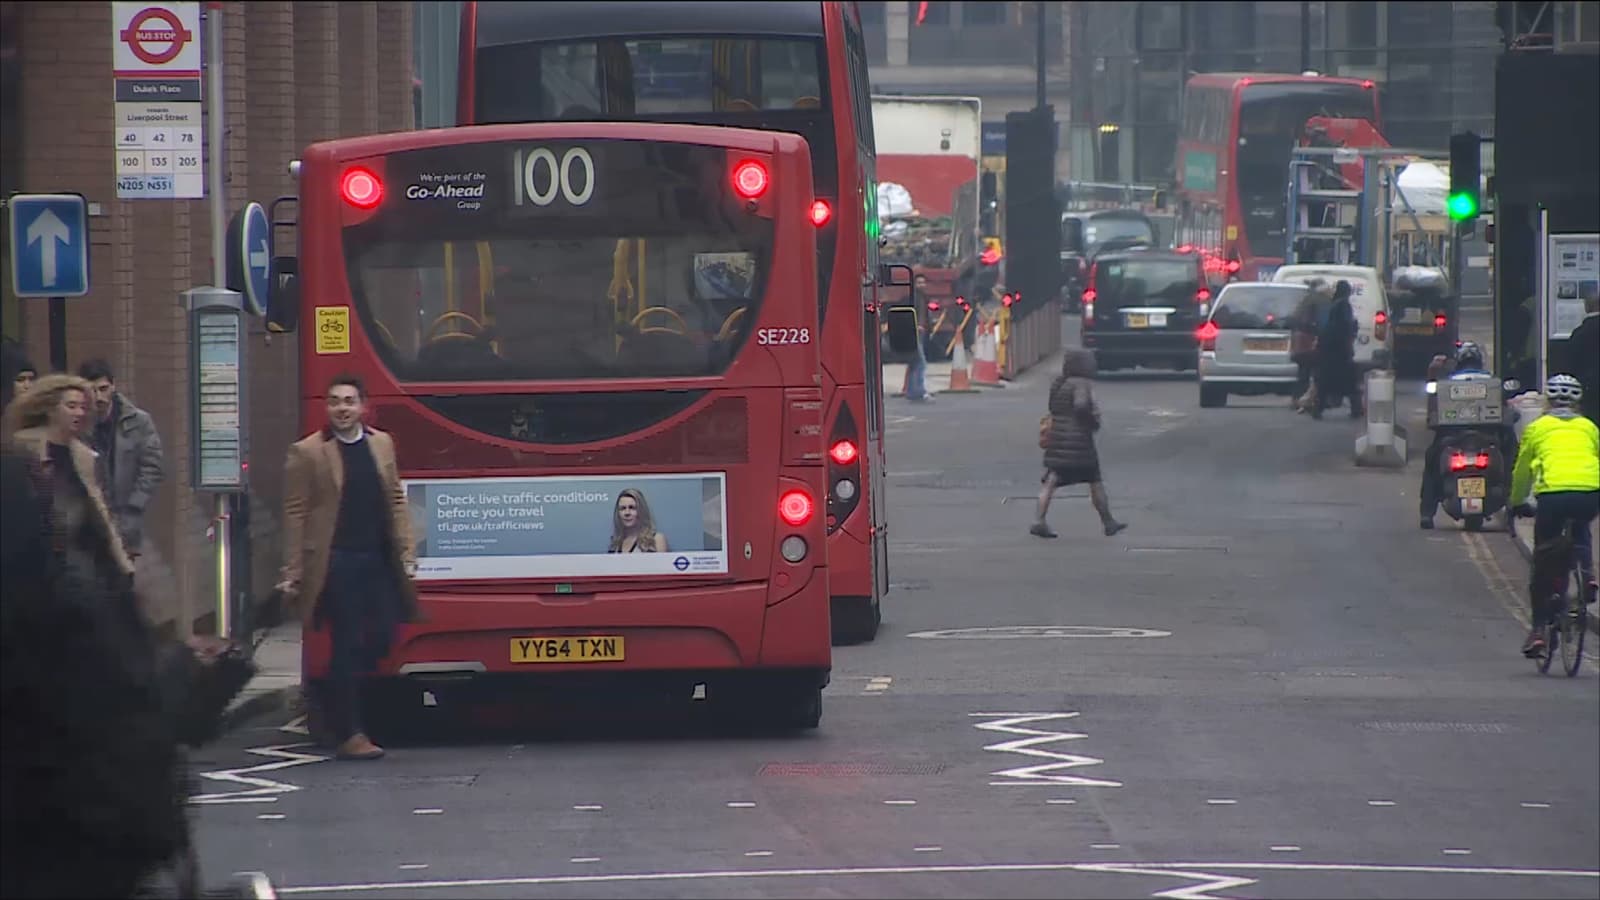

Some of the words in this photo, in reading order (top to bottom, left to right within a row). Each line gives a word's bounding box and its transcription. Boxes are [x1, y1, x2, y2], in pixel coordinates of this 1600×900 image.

[135, 32, 152, 40] BUS
[154, 32, 176, 40] STOP
[160, 84, 182, 93] Place
[127, 114, 163, 122] Liverpool
[124, 133, 136, 142] 40
[152, 133, 165, 142] 42
[181, 133, 193, 142] 78
[122, 157, 139, 167] 100
[151, 157, 168, 167] 135
[179, 157, 197, 167] 205
[419, 172, 442, 182] We're
[443, 172, 462, 183] part
[463, 172, 472, 182] of
[473, 171, 486, 181] the
[513, 146, 595, 206] 100
[117, 180, 144, 190] N205
[147, 181, 172, 190] N551
[405, 183, 485, 199] Go-Ahead
[456, 200, 481, 210] Group
[757, 327, 810, 345] SE228
[436, 493, 476, 506] Check
[478, 493, 500, 505] live
[502, 492, 543, 504] traffic
[543, 490, 609, 504] conditions
[436, 507, 479, 519] before
[481, 508, 505, 521] you
[508, 505, 545, 517] travel
[519, 639, 571, 659] YY64
[577, 638, 616, 658] TXN
